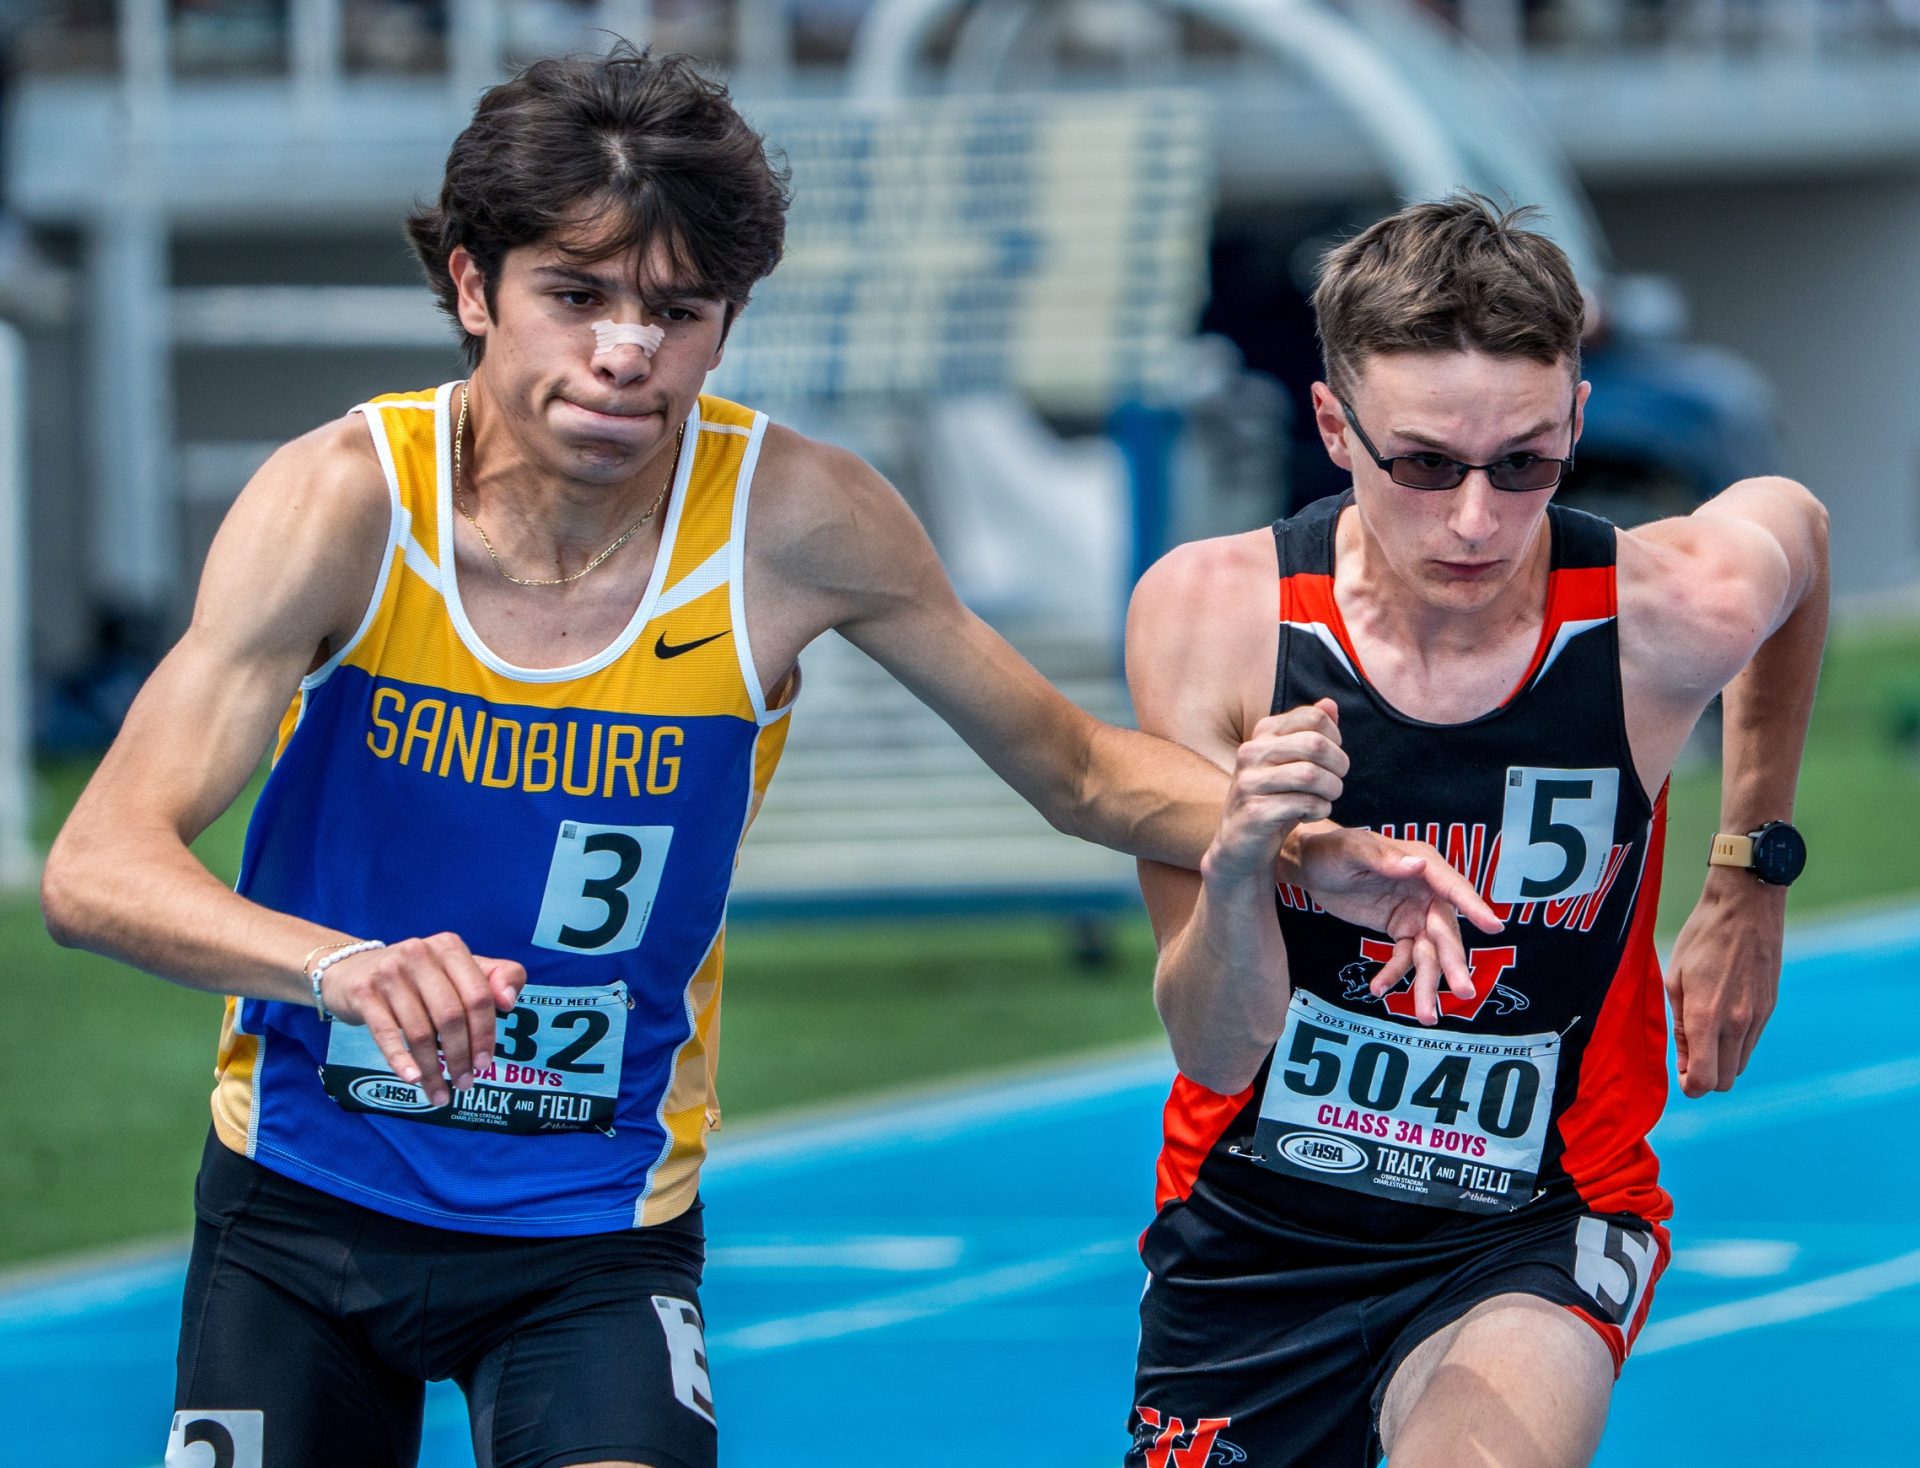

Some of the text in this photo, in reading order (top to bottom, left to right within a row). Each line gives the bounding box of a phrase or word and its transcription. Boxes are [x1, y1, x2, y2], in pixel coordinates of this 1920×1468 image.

[366, 687, 685, 798] SANDBURG
[1520, 779, 1594, 899] 5
[557, 832, 643, 951] 3
[530, 996, 562, 1006] FIELD
[567, 998, 599, 1006] MEET
[1315, 1012, 1533, 1057] 2025 IHSA STATE TRACK & FIELD MEET
[505, 1063, 563, 1088] BOYS
[1283, 1019, 1541, 1139] 5040
[452, 1085, 592, 1122] TRACK AND FIELD
[1317, 1104, 1488, 1157] CLASS 3A BOYS
[1376, 1146, 1512, 1195] TRACK AND FIELD
